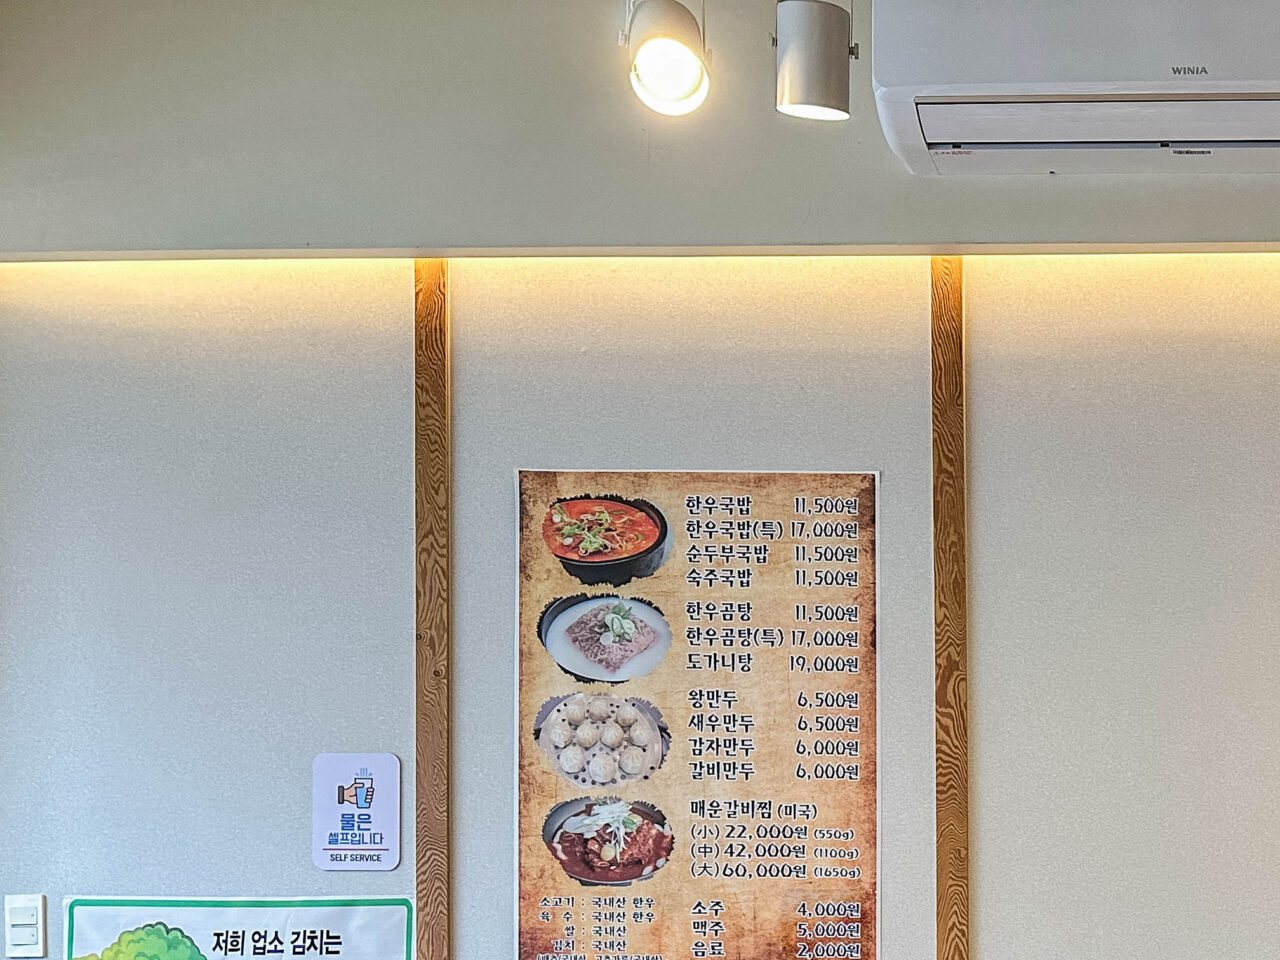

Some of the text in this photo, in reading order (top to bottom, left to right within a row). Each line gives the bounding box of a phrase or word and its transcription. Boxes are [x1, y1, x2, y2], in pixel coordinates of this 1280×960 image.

[1171, 66, 1208, 75] WINIA
[685, 496, 858, 515] 한우국밥 11,500원
[685, 520, 858, 540] 한우국밥(특) 17,000원
[686, 544, 858, 564] 순두부국밥 11,500원
[686, 568, 858, 588] 숙주국밥 11,500원
[686, 602, 858, 622] 한우곰탕 11,500원
[686, 627, 858, 648] 한우곰탕(특) 17,000원
[686, 652, 858, 673] 도가니탕 19,000원
[688, 690, 858, 709] 왕만두 6,500원
[688, 714, 858, 733] 새우만두 6,500원
[688, 737, 858, 757] 감자만두 6,000원
[688, 761, 858, 780] 갈비만두 6,000원
[691, 800, 817, 820] 매운갈비찜 (미국)
[340, 813, 372, 831] 물은
[328, 832, 384, 845] 셀프입니다
[691, 824, 854, 840] (小) 22,000원 (550g)
[330, 854, 382, 862] SELF SERVICE
[691, 843, 859, 860] (中) 42,000원 (1100g)
[814, 867, 861, 879] (1650g)
[540, 896, 575, 908] 소고기
[591, 897, 626, 908] 국내산
[632, 896, 655, 909] 한우
[691, 901, 860, 917] 소주 4,000원
[592, 911, 626, 923] 국내산
[632, 911, 655, 923] 한우
[564, 925, 575, 937] 쌀
[592, 925, 627, 937] 국내산
[692, 921, 860, 938] 맥주 5,000원
[212, 930, 342, 955] 저희 업소 김치는
[552, 940, 575, 951] 김치
[592, 940, 626, 951] 국내산
[691, 941, 860, 958] 음료 2,000원
